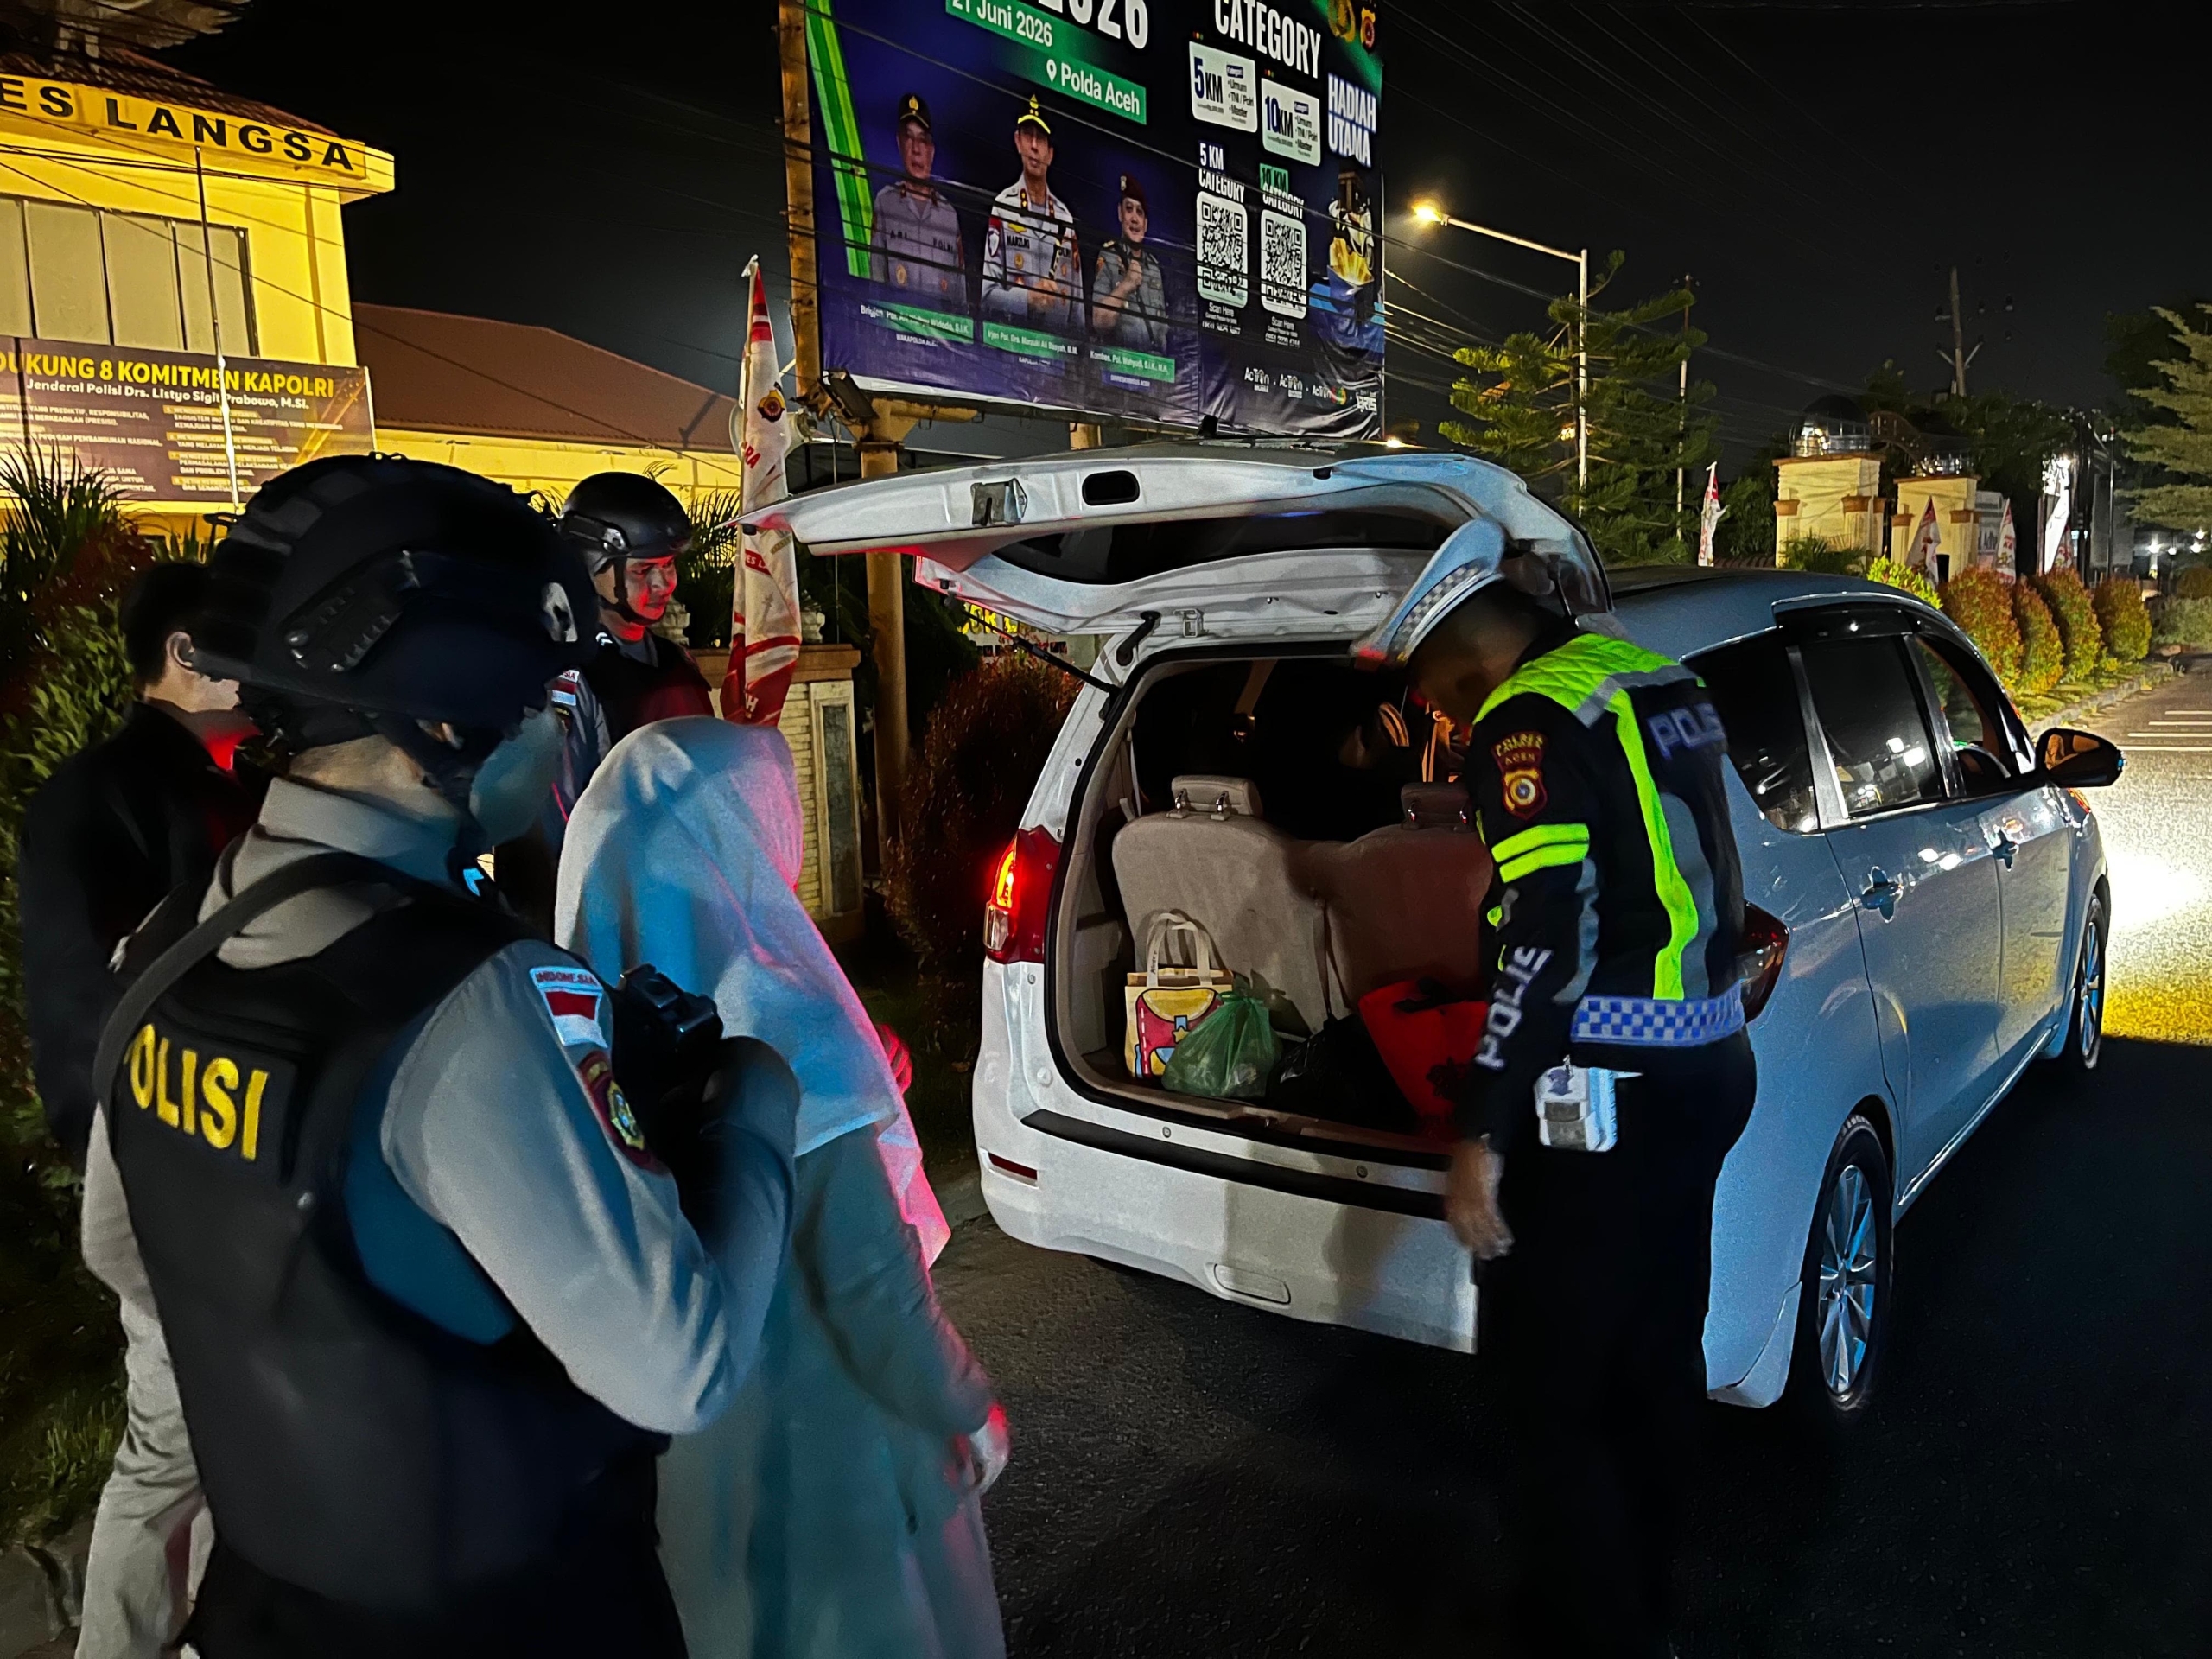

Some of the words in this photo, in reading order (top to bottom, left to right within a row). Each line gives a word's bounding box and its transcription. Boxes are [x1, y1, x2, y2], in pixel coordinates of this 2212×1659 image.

[976, 0, 1013, 30] Juni
[1016, 10, 1052, 47] 2026
[1038, 0, 1148, 49] 26
[1214, 0, 1321, 79] CATEGORY
[1061, 62, 1102, 101] Polda
[1105, 80, 1140, 115] Aceh
[1328, 73, 1376, 133] HADIAH
[0, 78, 73, 118] ES
[105, 97, 354, 170] LANGSA
[1328, 113, 1371, 168] UTAMA
[1199, 143, 1207, 166] 5
[1209, 145, 1224, 170] KM
[1198, 168, 1245, 204] CATEGORY
[27, 378, 85, 393] Jenderal
[86, 383, 123, 396] Polisi
[124, 386, 149, 398] Drs.
[152, 388, 190, 403] Listyo
[193, 391, 220, 404] Sigit
[226, 394, 278, 409] Prabowo,
[280, 397, 309, 410] M.Si.
[99, 359, 114, 381] 8
[118, 360, 239, 390] KOMITMEN
[245, 372, 334, 397] KAPOLRI
[123, 1023, 270, 1161] OLISI
